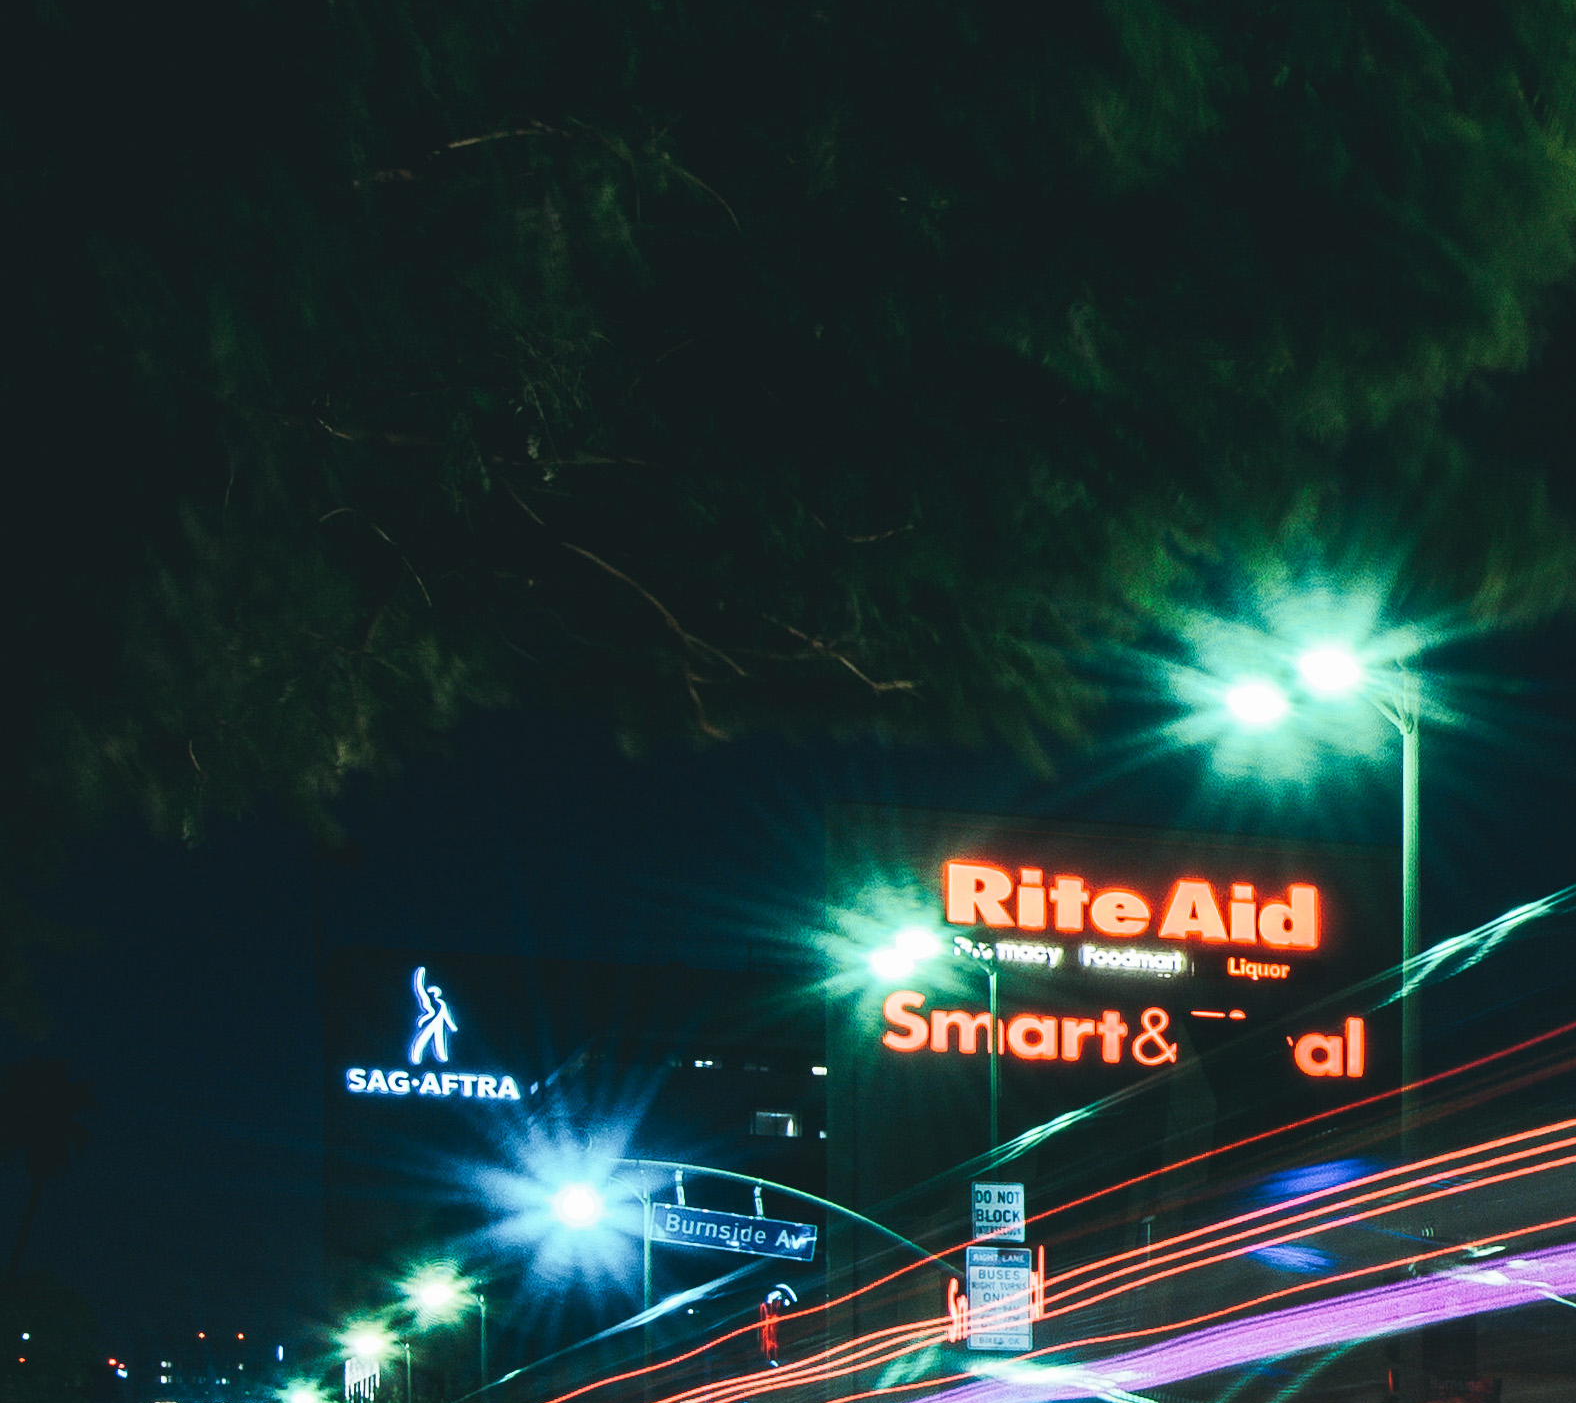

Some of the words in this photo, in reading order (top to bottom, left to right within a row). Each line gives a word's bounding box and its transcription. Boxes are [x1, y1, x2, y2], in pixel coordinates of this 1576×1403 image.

[945, 860, 1152, 937] Rite
[1157, 877, 1322, 951] Aid
[1081, 943, 1185, 973] Foodmart
[1226, 956, 1291, 980] Liquor
[882, 989, 1129, 1064] Smart
[1131, 1006, 1178, 1067] &
[974, 1190, 992, 1204] DO
[997, 1190, 1021, 1205] NOT
[664, 1212, 767, 1245] Burnside
[976, 1209, 1021, 1223] BLOCK
[978, 1269, 1021, 1281] BUSES
